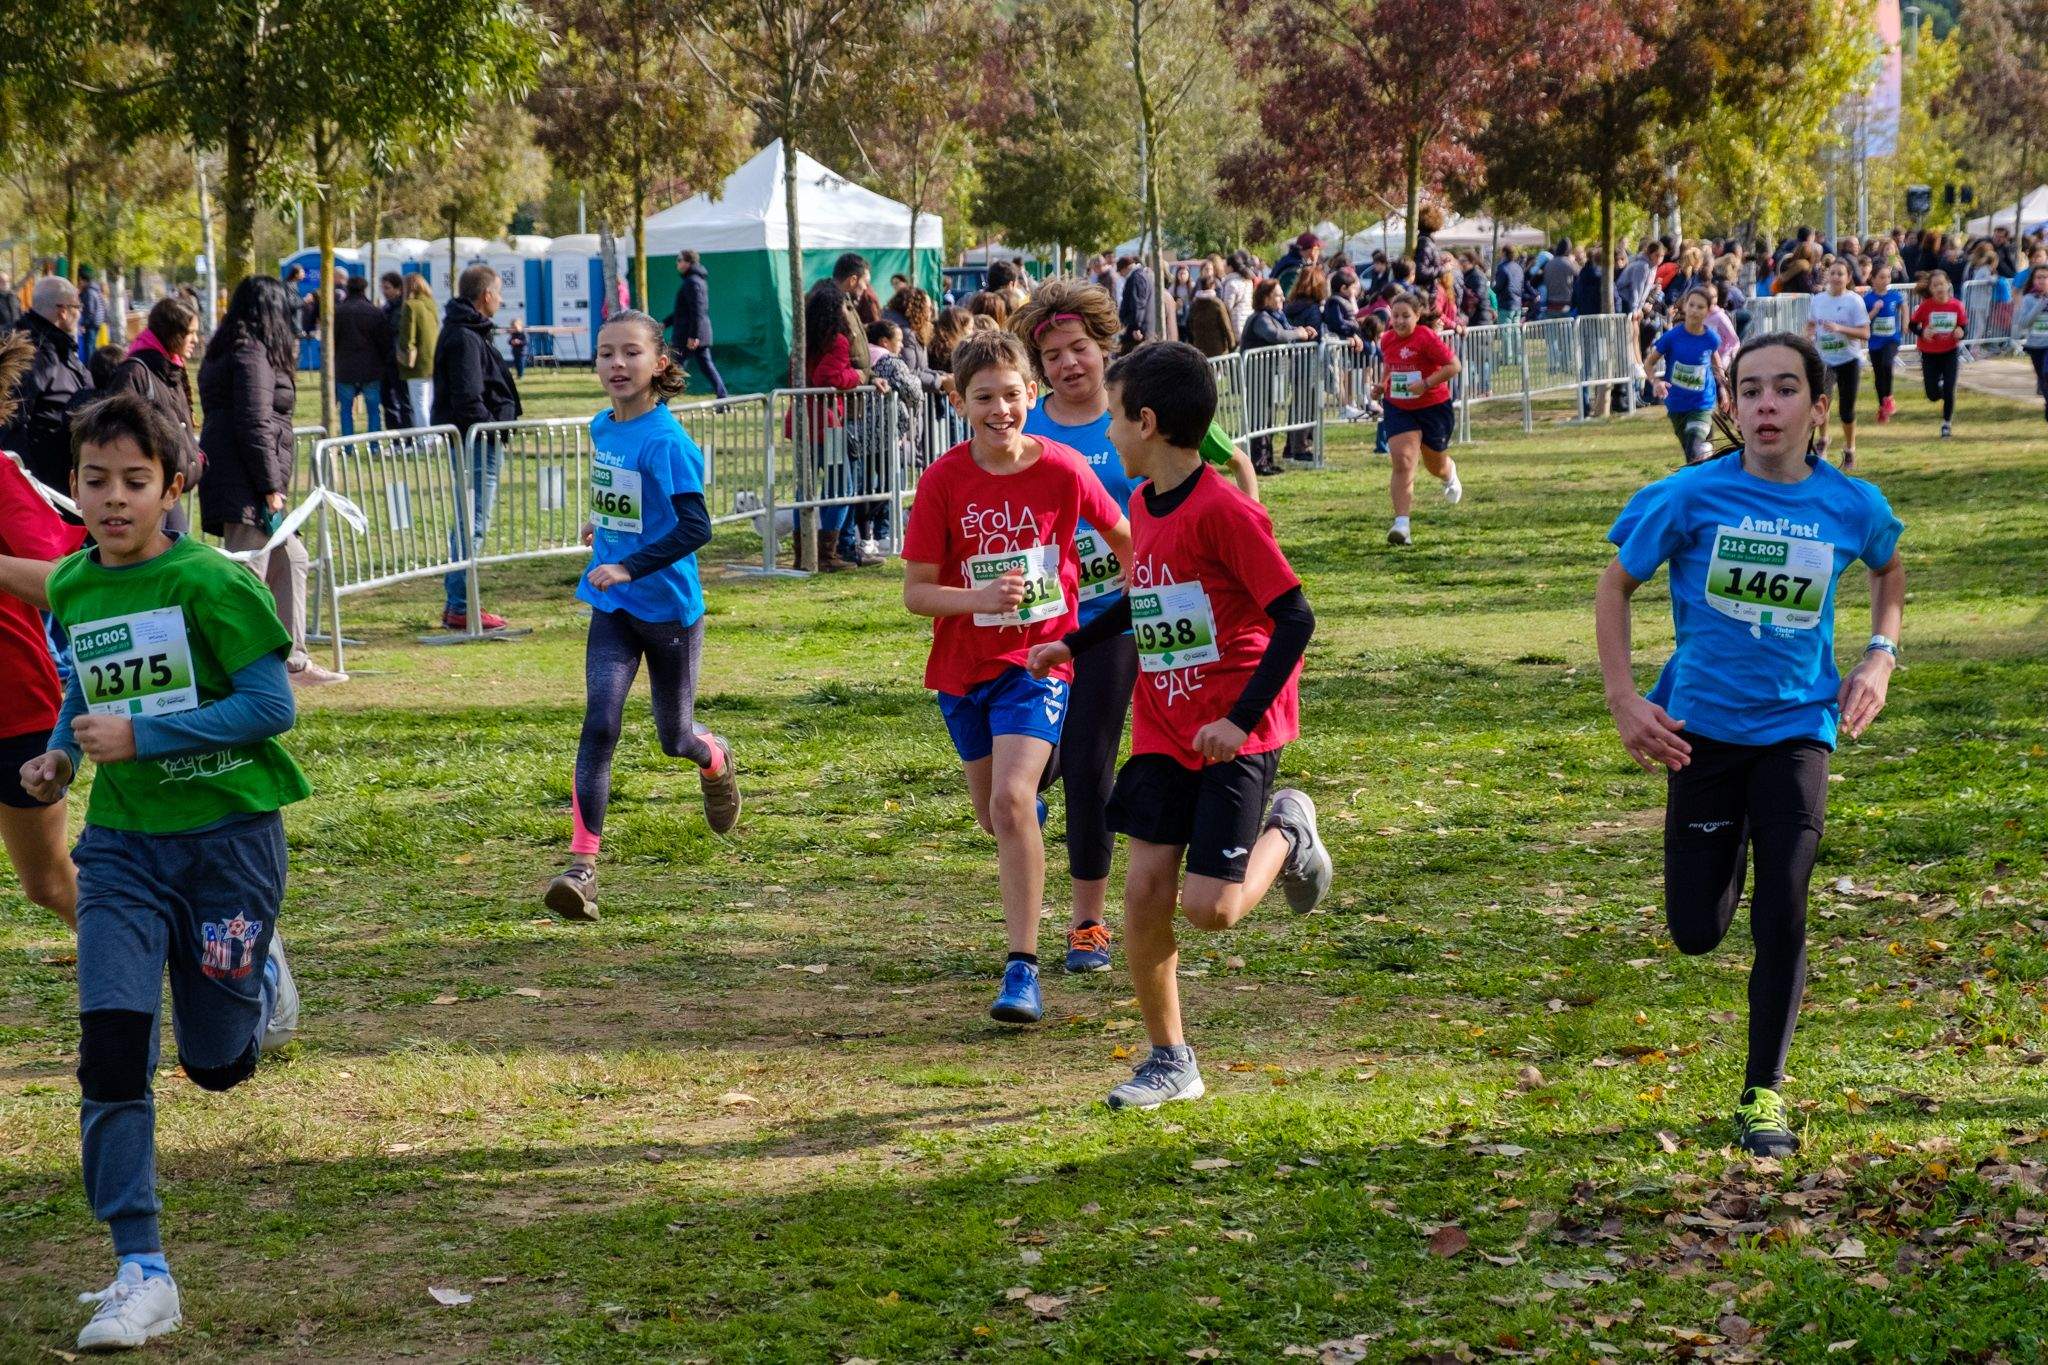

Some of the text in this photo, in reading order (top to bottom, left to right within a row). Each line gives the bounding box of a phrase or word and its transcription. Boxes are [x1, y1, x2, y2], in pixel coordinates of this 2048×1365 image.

[1086, 452, 1109, 465] nt!
[592, 487, 631, 514] 1466
[1077, 540, 1092, 550] OS
[1721, 540, 1785, 556] 21è CROS
[974, 562, 994, 574] 21è
[996, 559, 1026, 571] CROS
[1080, 552, 1121, 582] 468
[1023, 577, 1050, 604] 31
[1724, 567, 1812, 606] 1467
[75, 635, 94, 653] 21è
[95, 628, 128, 647] CROS
[1134, 618, 1197, 650] 1938
[89, 652, 173, 698] 2375
